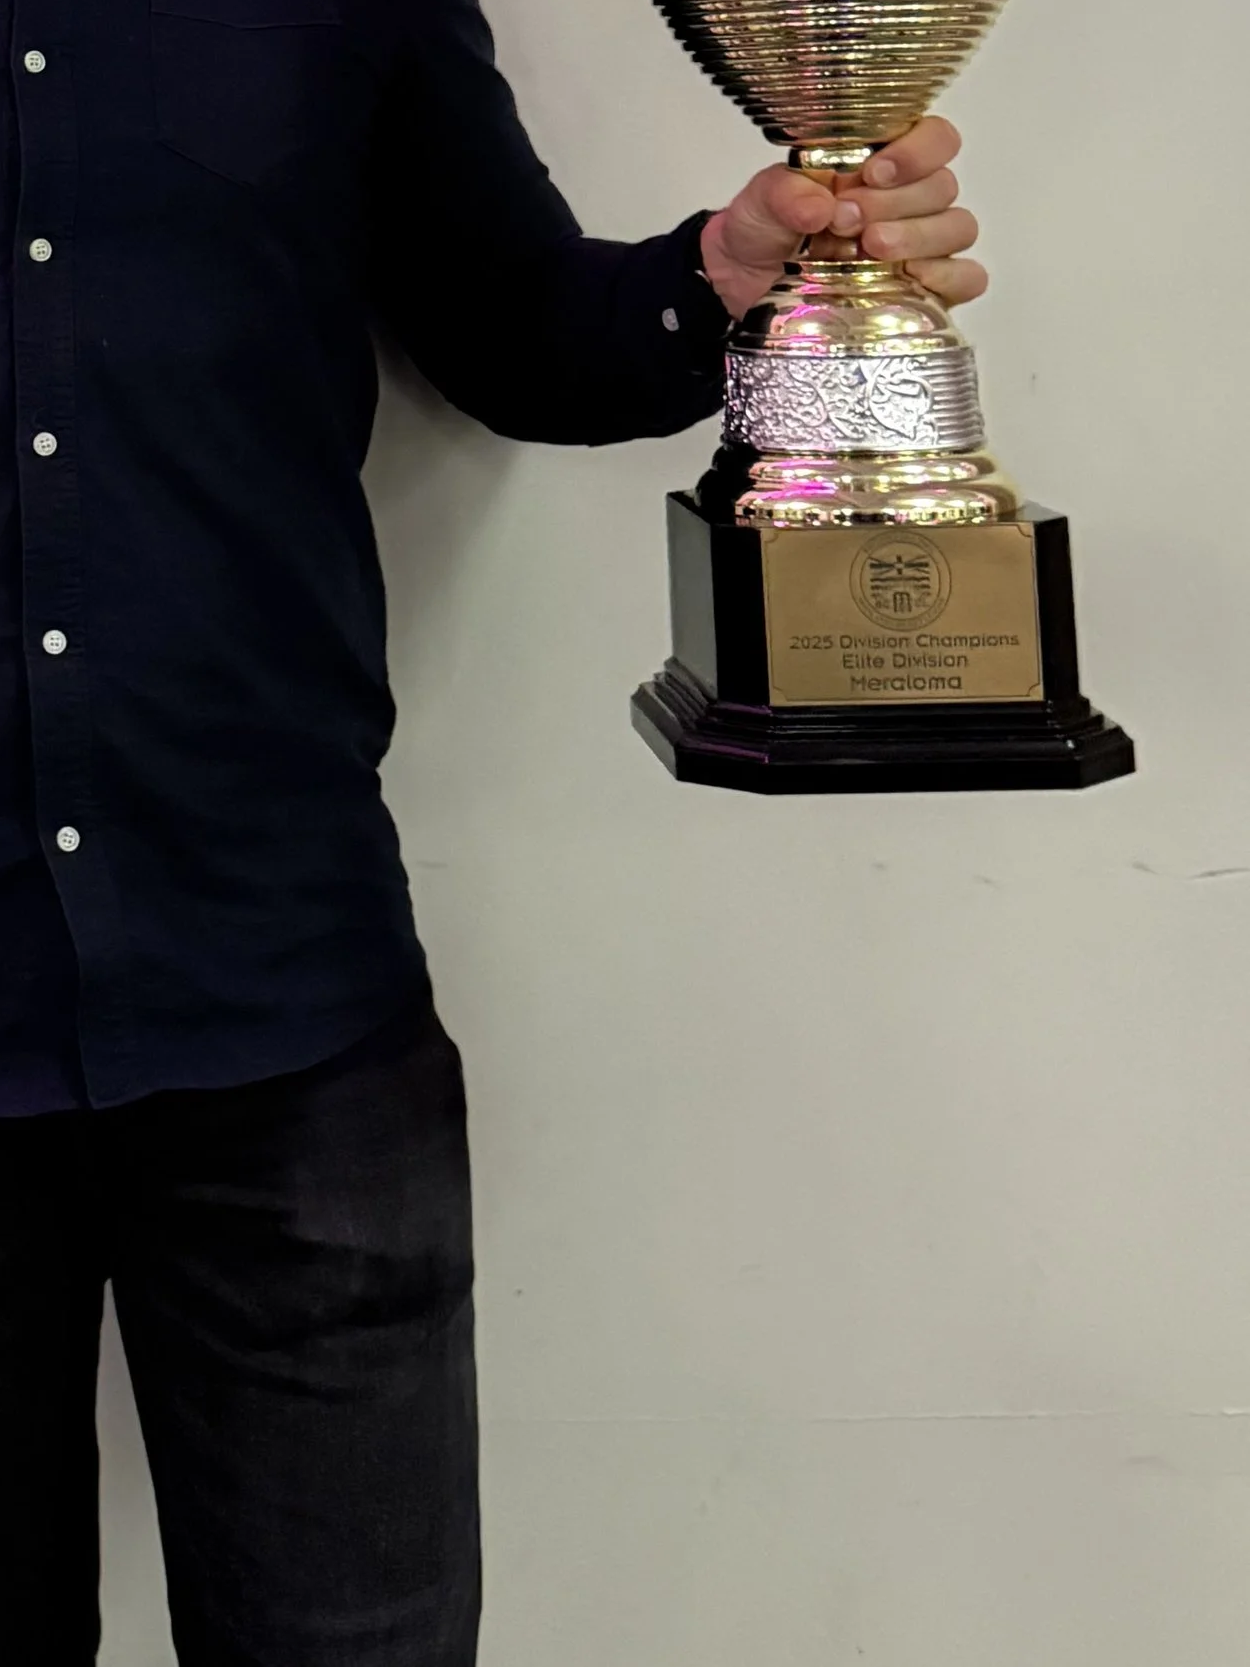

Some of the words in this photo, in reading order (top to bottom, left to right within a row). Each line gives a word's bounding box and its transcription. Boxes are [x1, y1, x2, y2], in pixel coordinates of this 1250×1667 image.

[789, 635, 834, 650] 2025
[839, 634, 910, 649] Division
[915, 633, 1020, 650] Champions
[842, 653, 885, 670] Elite
[892, 652, 969, 669] Division
[850, 674, 962, 692] Meraloma
